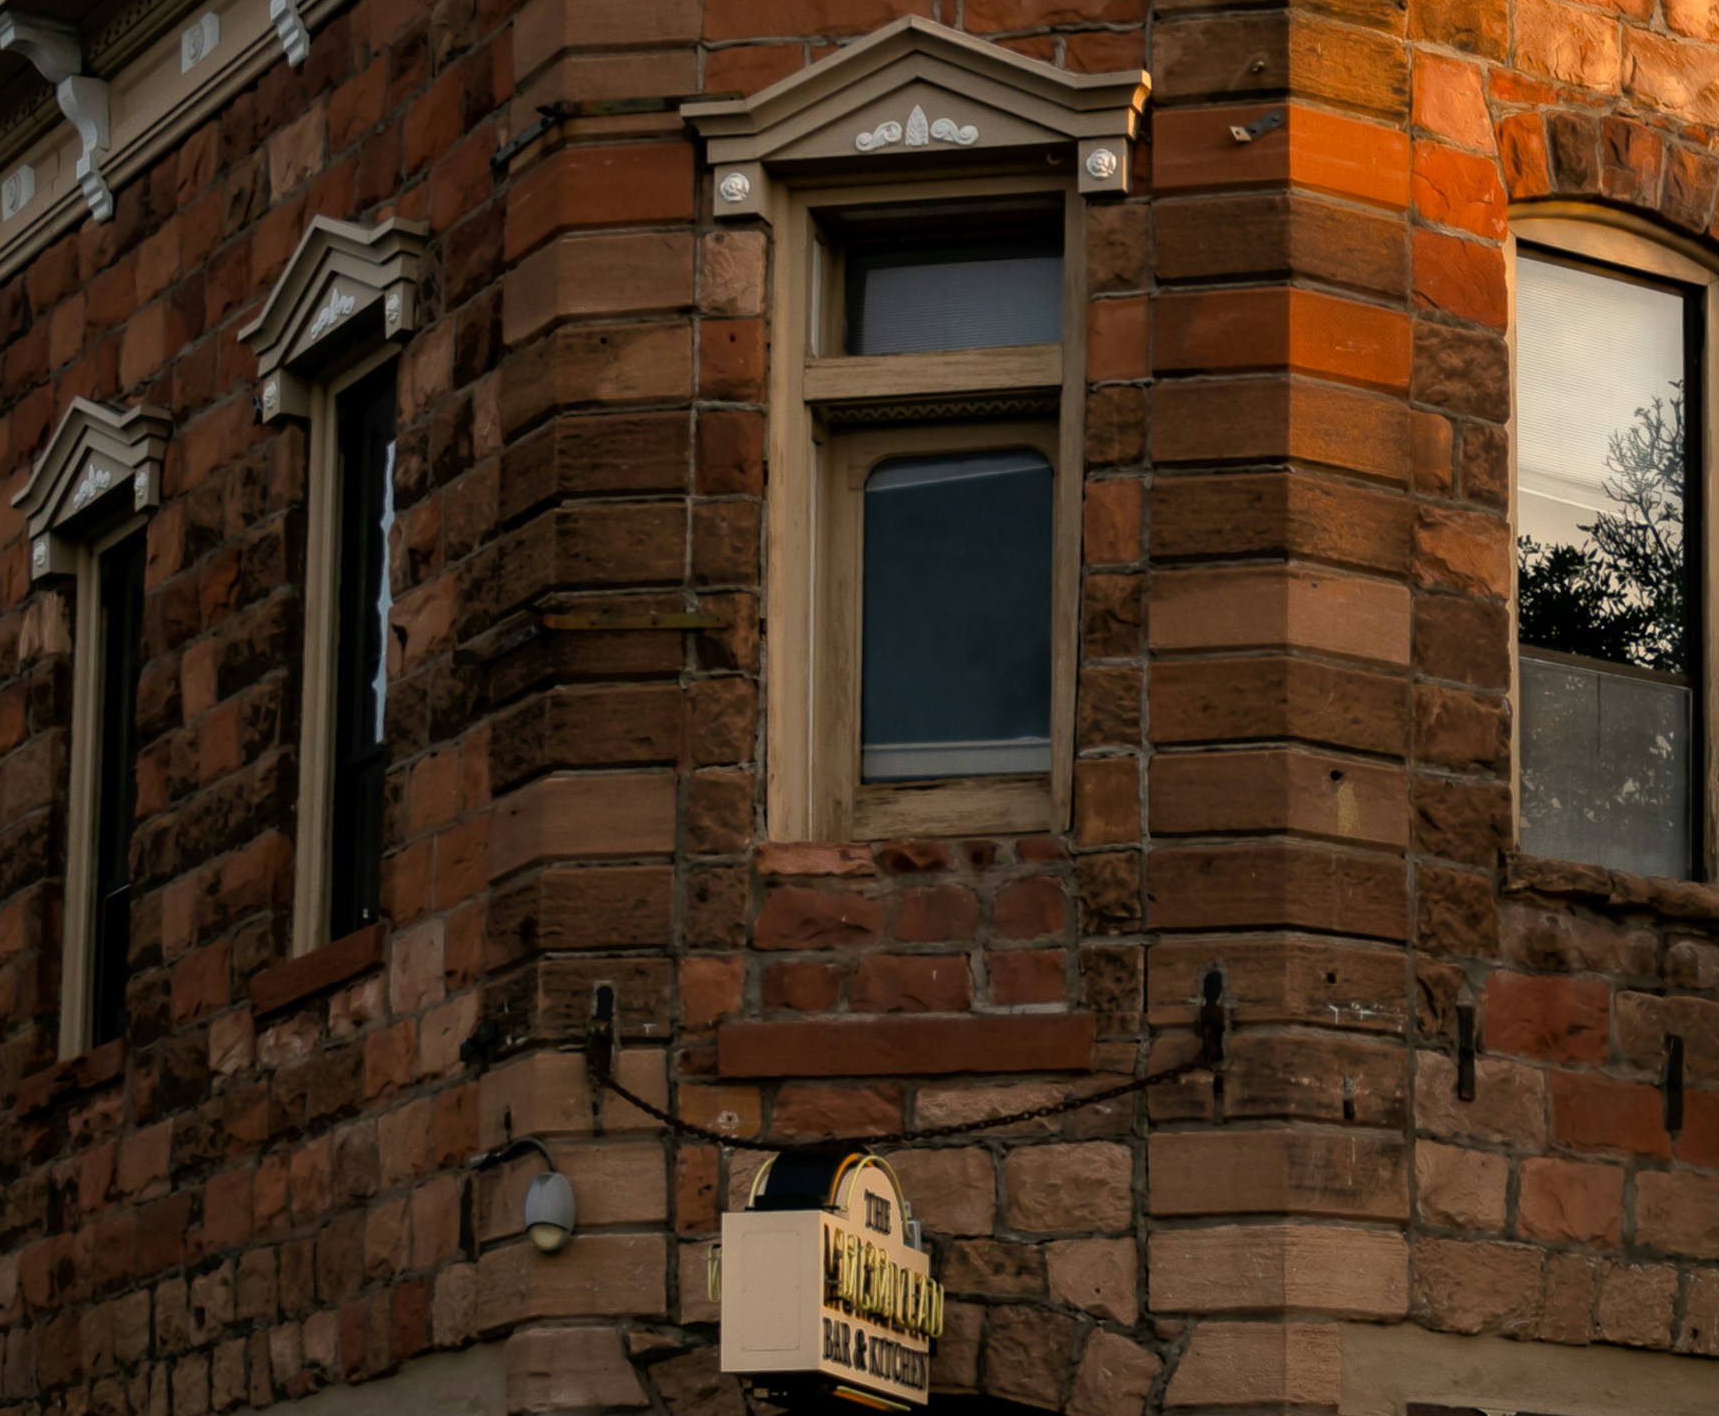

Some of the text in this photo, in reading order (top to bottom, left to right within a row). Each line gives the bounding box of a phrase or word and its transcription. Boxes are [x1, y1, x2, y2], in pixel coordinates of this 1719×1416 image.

[865, 1189, 892, 1235] THE
[822, 1317, 929, 1390] BAR & KITCHEN
